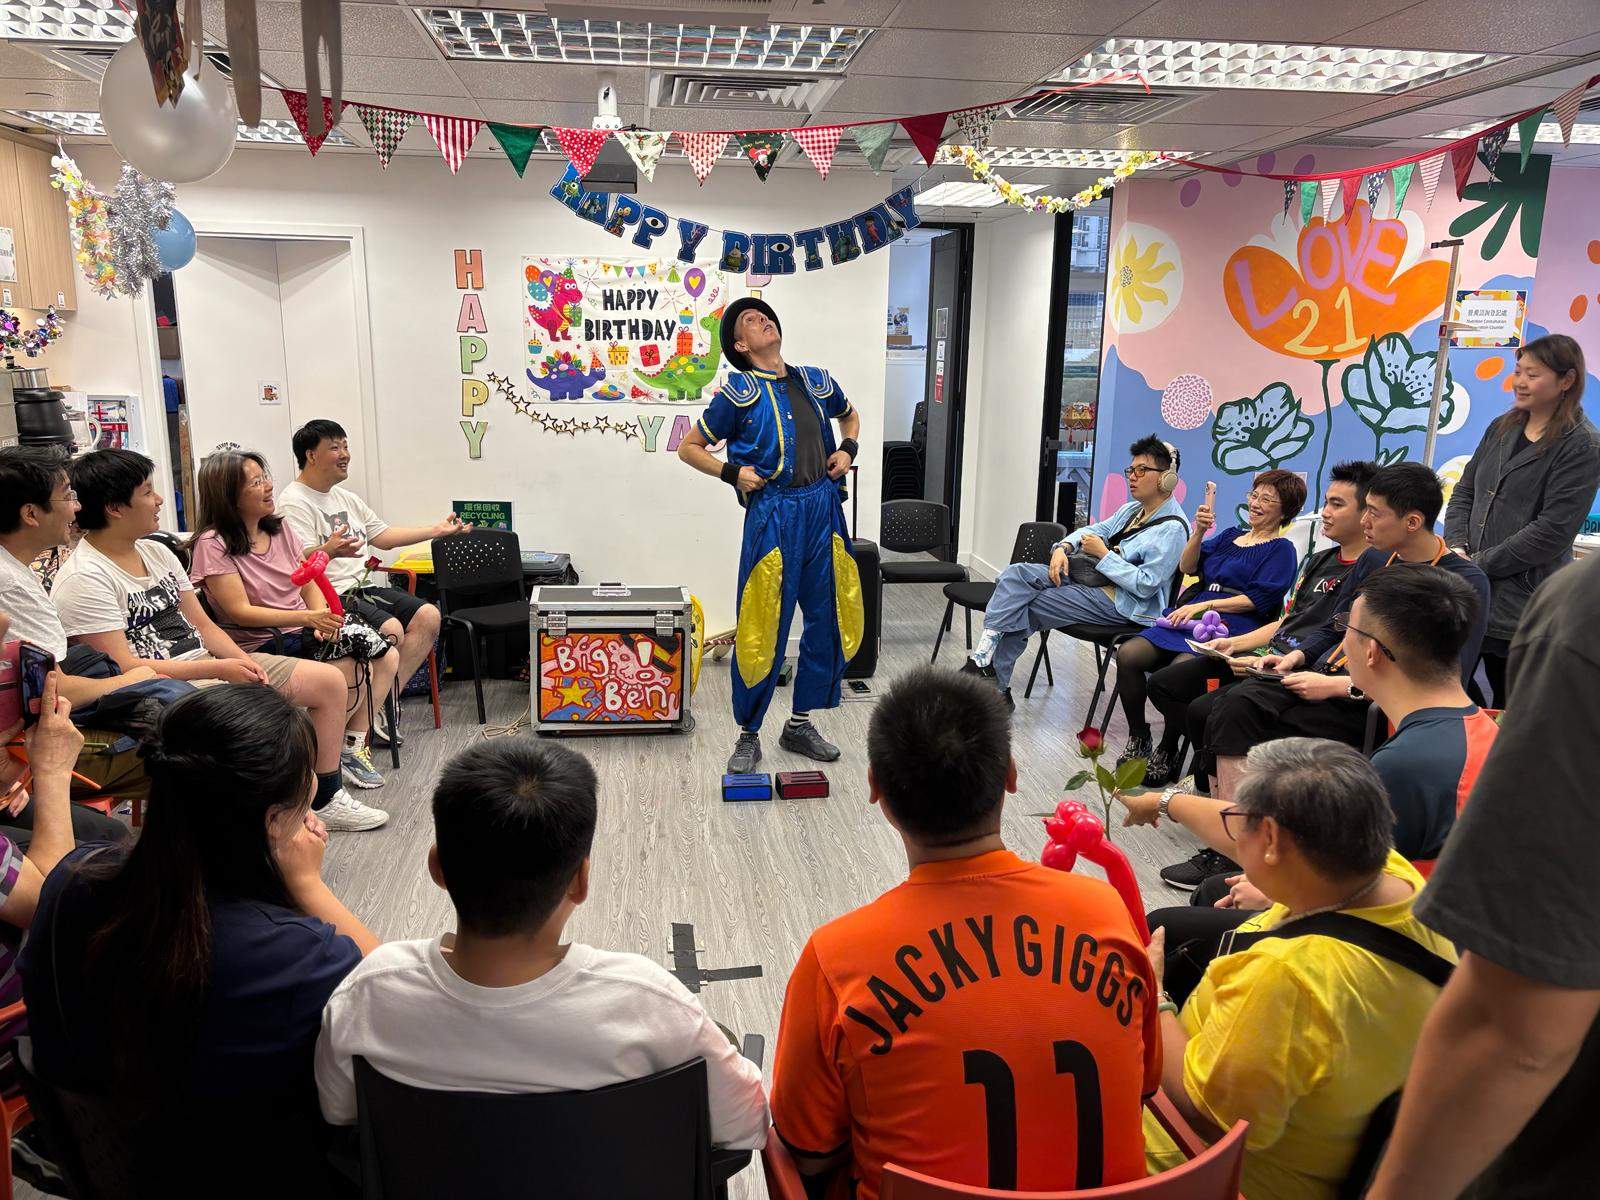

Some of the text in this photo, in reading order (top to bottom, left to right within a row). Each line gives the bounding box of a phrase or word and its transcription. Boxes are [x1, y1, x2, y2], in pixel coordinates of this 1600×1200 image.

[719, 184, 921, 275] BIRTHDAY
[1234, 205, 1406, 330] LOVE
[602, 288, 659, 311] HAPPY
[1283, 286, 1368, 355] 21
[454, 249, 489, 458] HAPPY
[584, 318, 676, 342] BIRTHDAY
[460, 511, 506, 520] RECYCLING
[555, 643, 610, 680] Big
[604, 678, 668, 712] Ben
[962, 1039, 1104, 1191] 11
